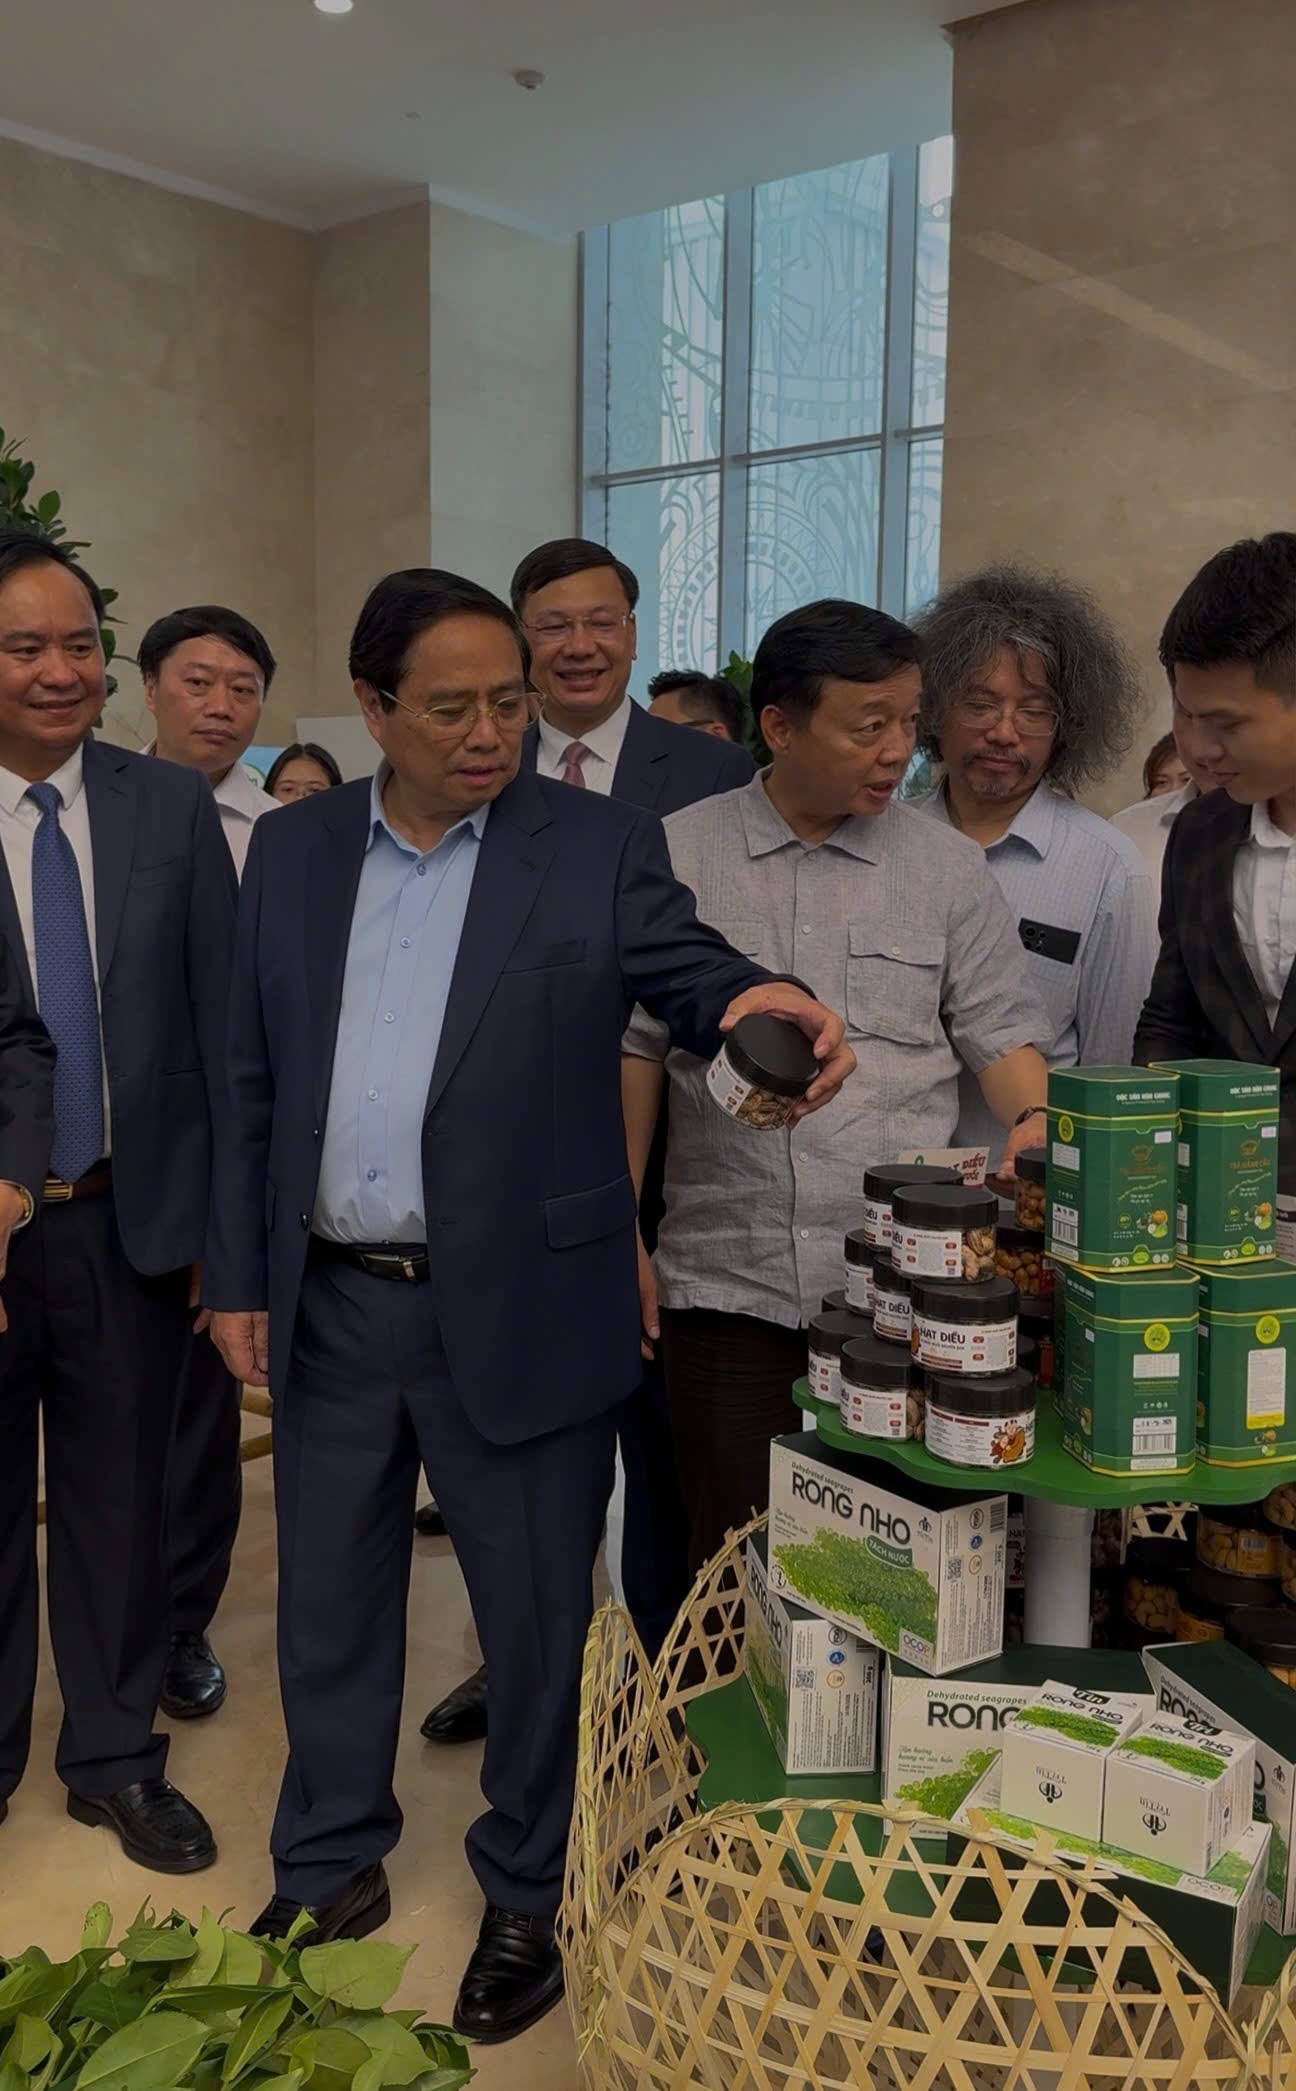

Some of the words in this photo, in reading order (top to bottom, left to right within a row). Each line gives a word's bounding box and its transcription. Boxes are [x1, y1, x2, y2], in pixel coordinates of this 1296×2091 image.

[792, 1471, 853, 1520] RONG
[859, 1503, 911, 1546] NHO
[926, 1690, 980, 1702] Dehydrated
[981, 1694, 1027, 1705] seagrapes
[1041, 1693, 1086, 1710] RONG
[1088, 1706, 1124, 1721] NHO
[1149, 1722, 1195, 1740] RONG
[1197, 1738, 1234, 1754] NHO
